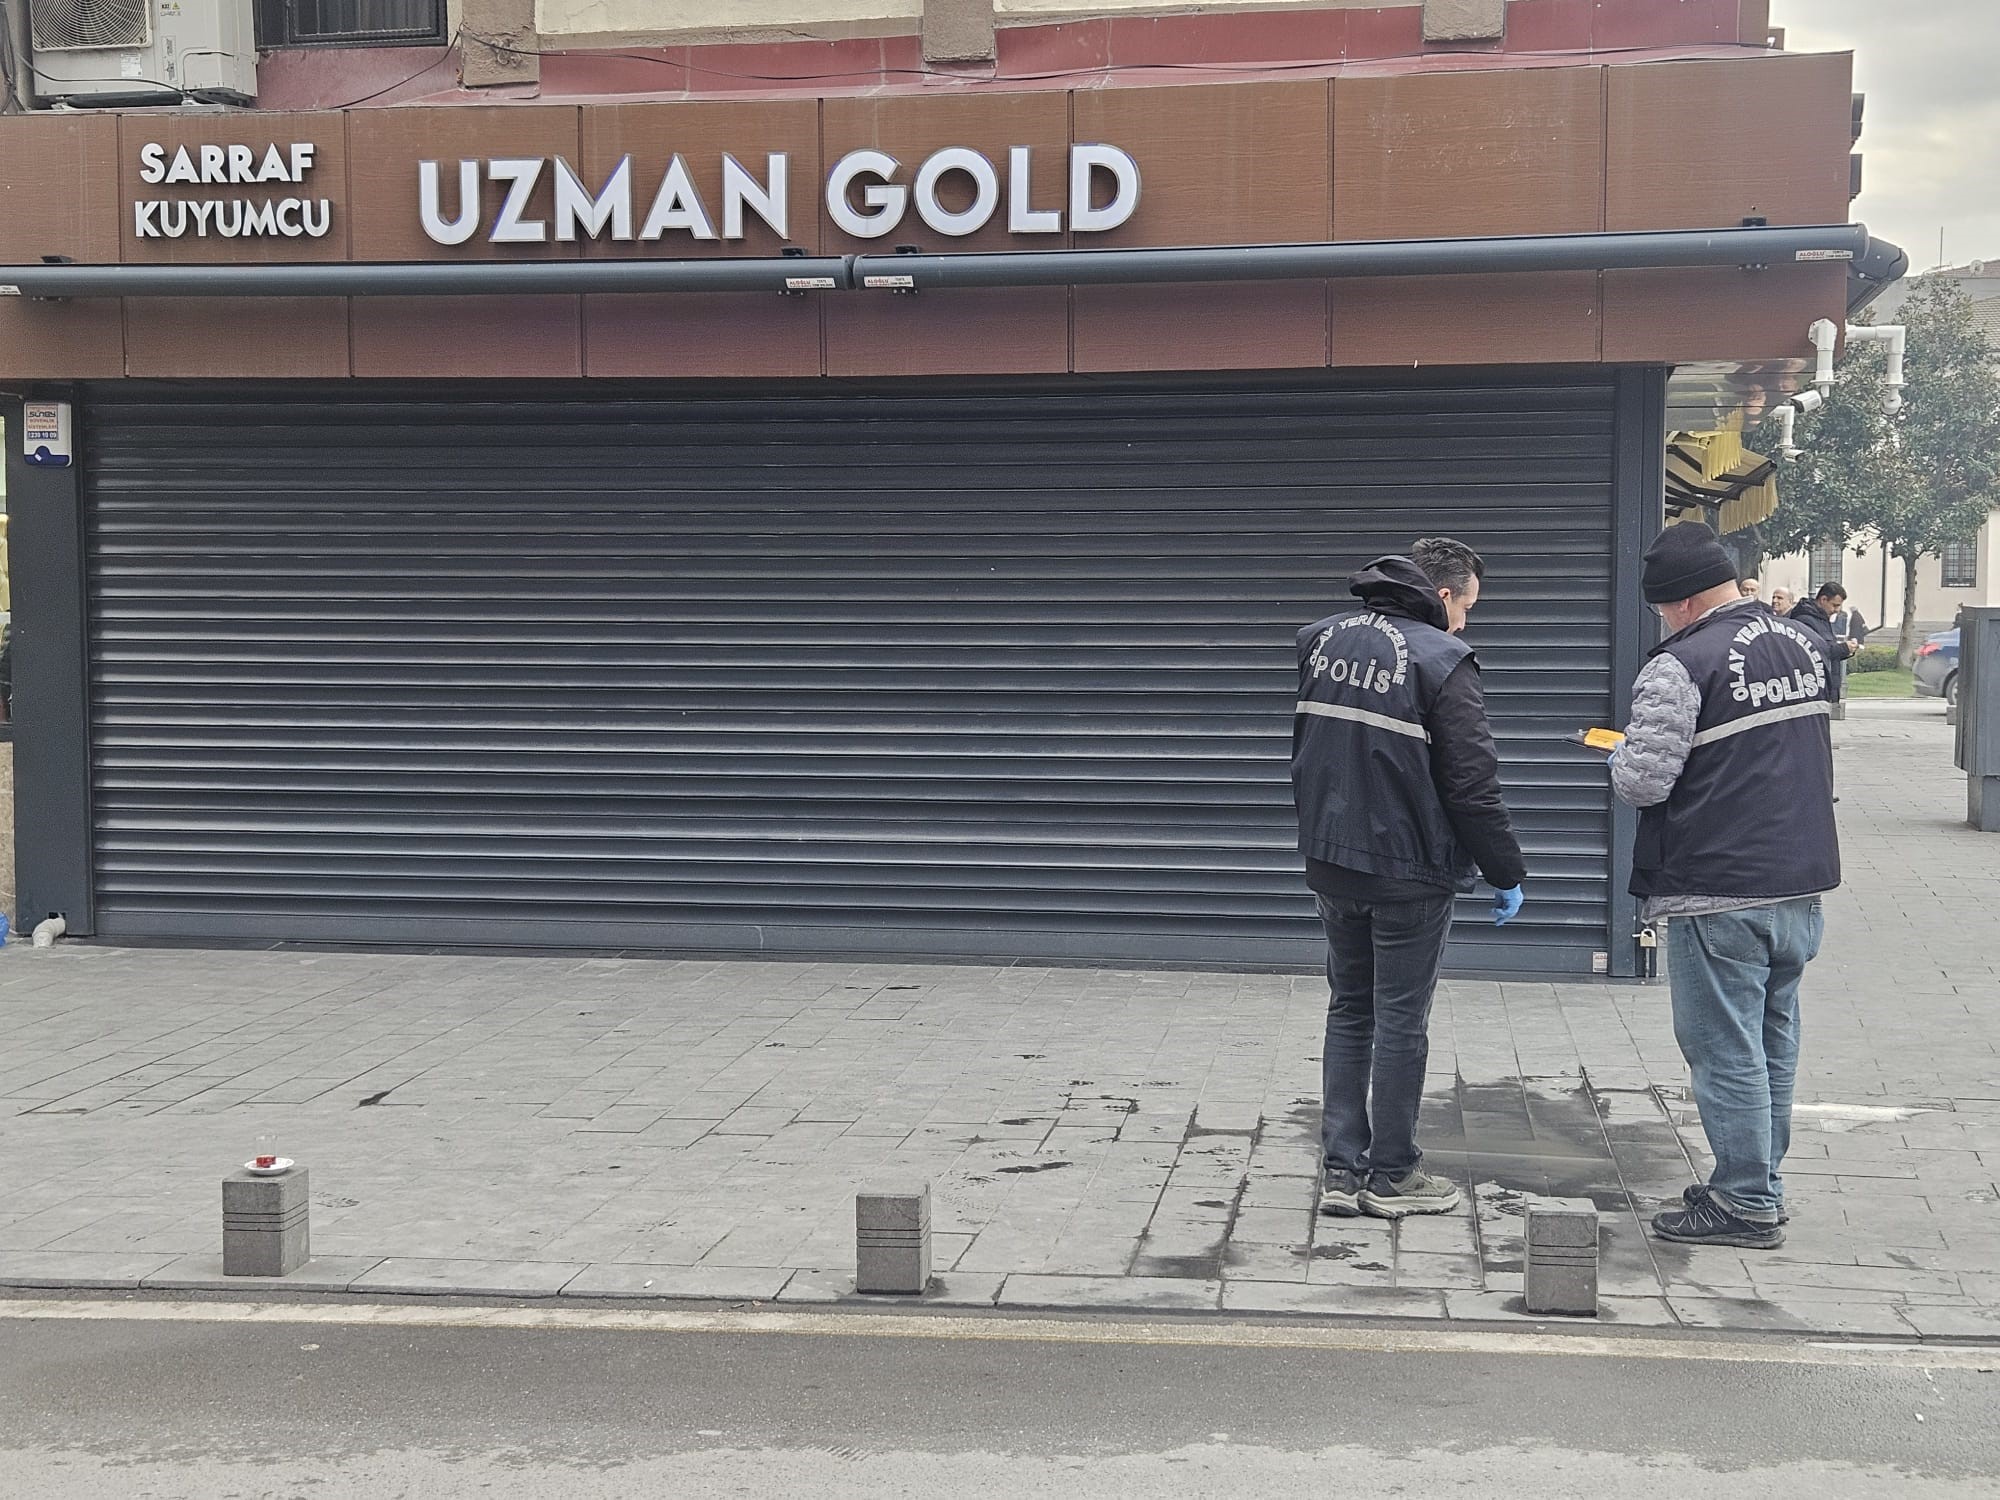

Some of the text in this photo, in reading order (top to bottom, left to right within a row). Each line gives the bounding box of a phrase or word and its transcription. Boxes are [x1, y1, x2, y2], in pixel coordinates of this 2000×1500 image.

[139, 142, 314, 184] SARRAF
[418, 142, 1142, 245] UZMAN GOLD
[134, 198, 330, 238] KUYUMCU
[1338, 612, 1376, 630] YERİ
[1373, 614, 1408, 686] İNCELEME
[1733, 616, 1769, 646] YERİ
[1313, 655, 1391, 694] POLİS
[1728, 647, 1749, 702] OLAY
[1748, 668, 1819, 707] POLİS
